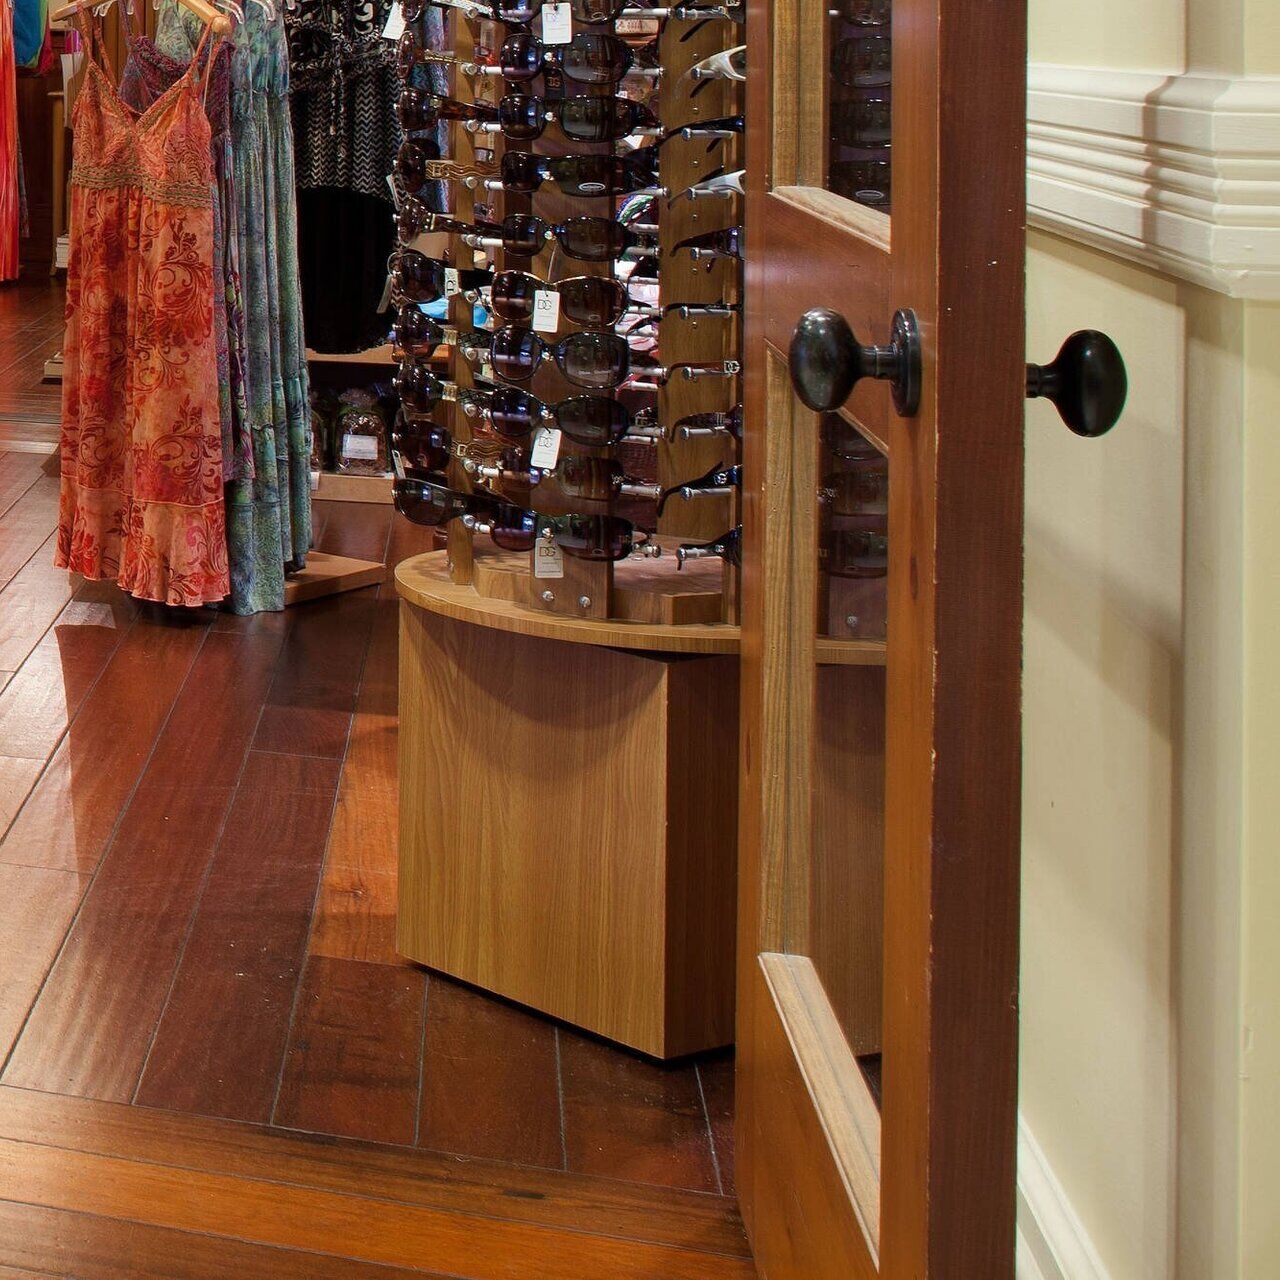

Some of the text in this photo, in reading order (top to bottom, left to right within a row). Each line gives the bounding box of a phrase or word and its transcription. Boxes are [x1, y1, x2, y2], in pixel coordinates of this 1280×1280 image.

[537, 299, 552, 311] DG
[723, 360, 740, 374] DG
[539, 546, 556, 557] DG
